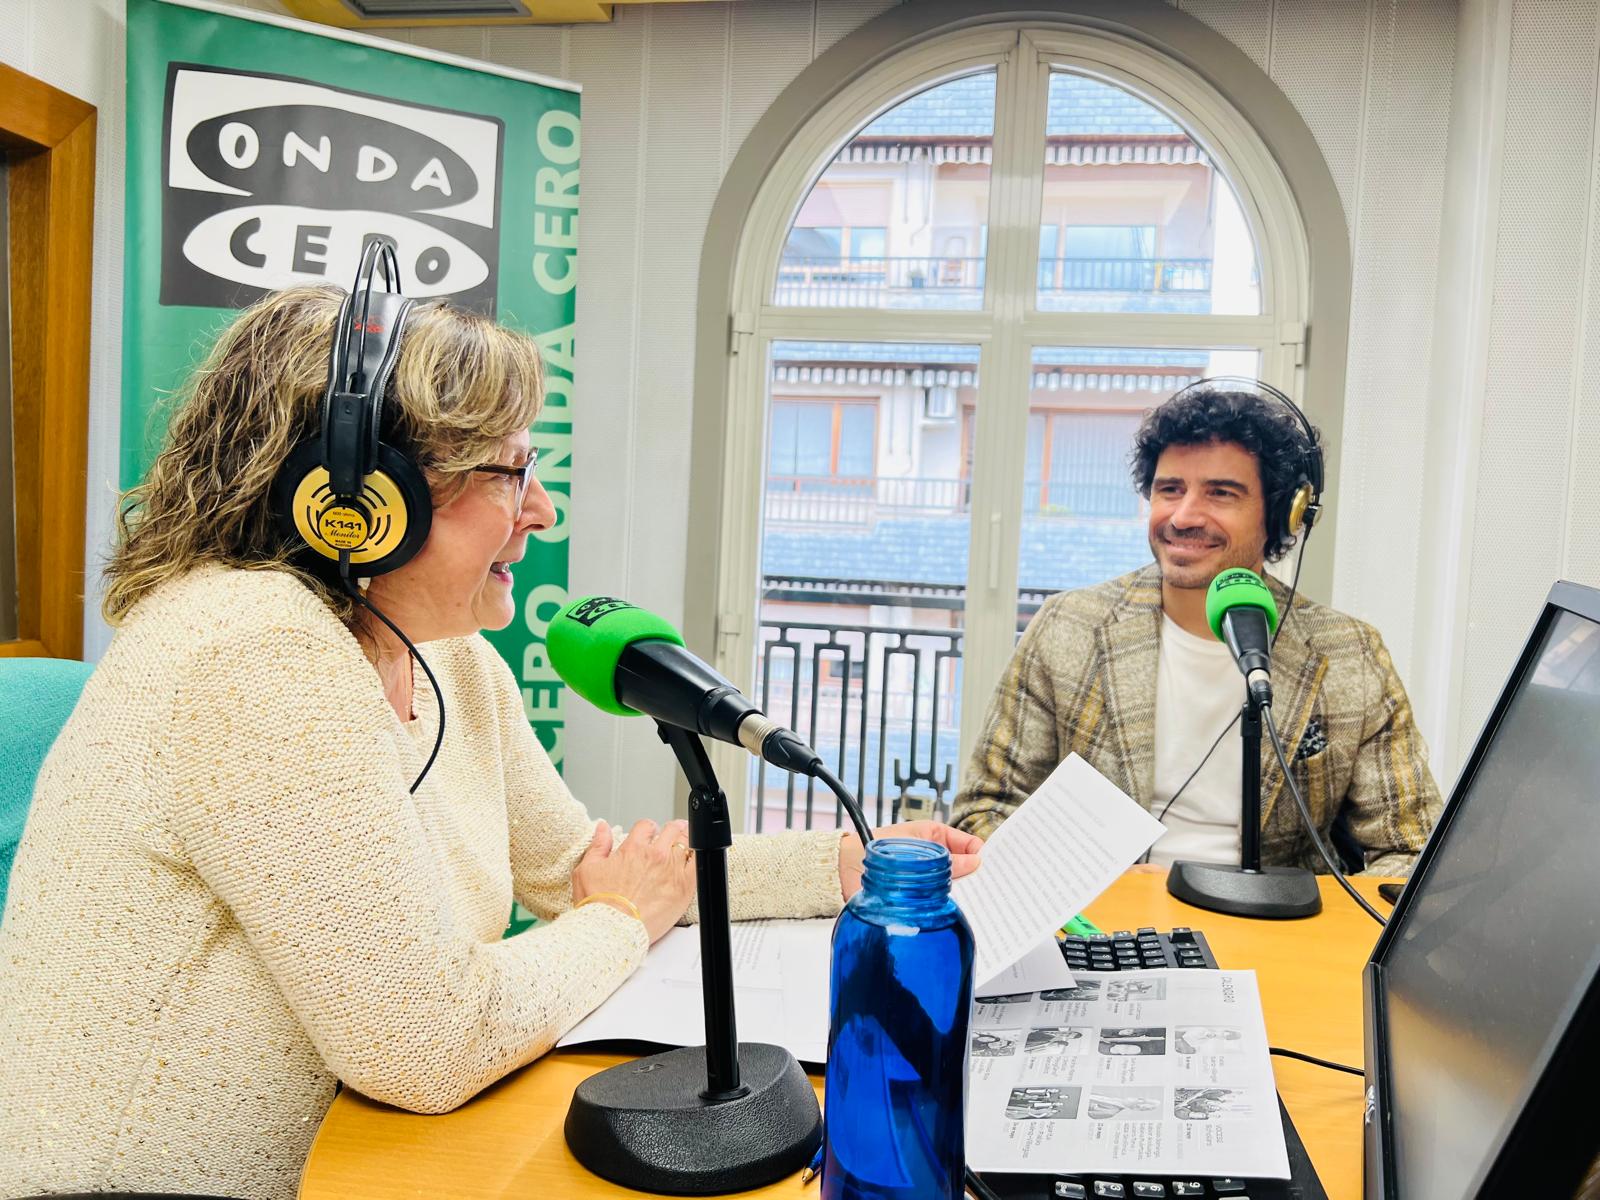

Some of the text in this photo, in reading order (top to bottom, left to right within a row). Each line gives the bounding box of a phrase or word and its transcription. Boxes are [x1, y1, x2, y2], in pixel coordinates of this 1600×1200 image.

[218, 121, 452, 197] ONDA
[532, 110, 580, 295] CERO
[230, 216, 451, 286] CERO
[325, 519, 362, 531] K141
